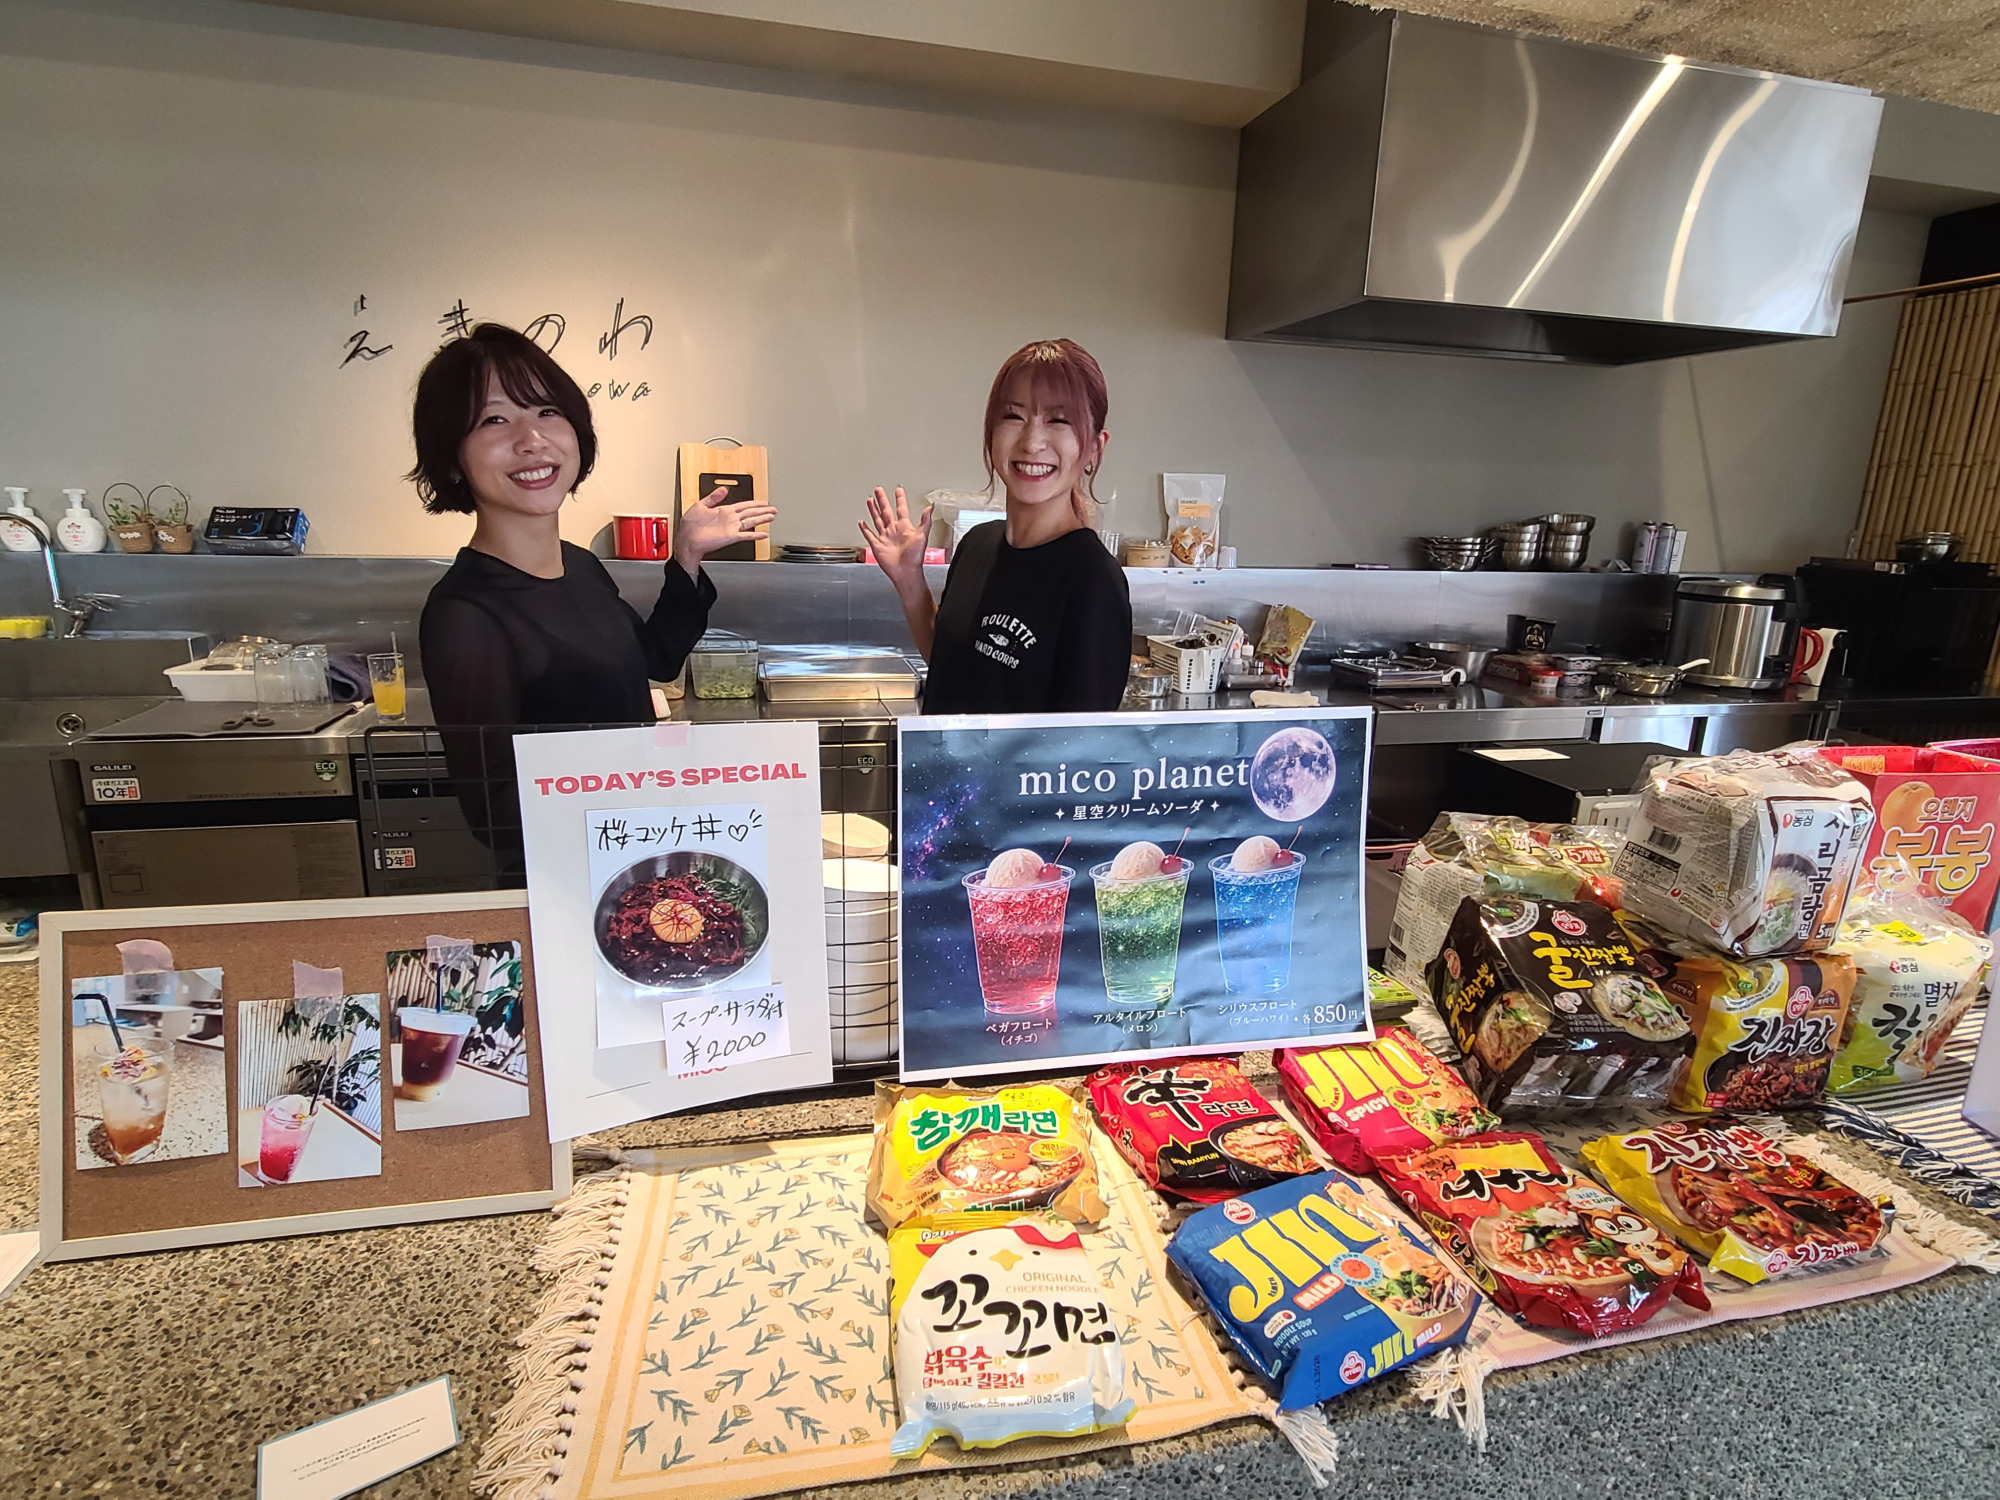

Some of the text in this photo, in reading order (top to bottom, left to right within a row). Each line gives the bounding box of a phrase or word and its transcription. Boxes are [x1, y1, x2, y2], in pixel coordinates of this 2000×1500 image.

[981, 614, 1037, 649] ROULETTE
[315, 762, 336, 771] ECO
[534, 763, 807, 796] TODAY'S SPECIAL
[1018, 757, 1249, 800] mico planet
[97, 786, 127, 798] 10年
[1072, 799, 1205, 821] 星空クリームソーダ
[1792, 815, 1814, 827] 농심
[1917, 796, 1977, 822] 오렌지
[1870, 823, 1995, 895] 봉봉
[1218, 1000, 1297, 1015] シリウスフロート
[1924, 981, 1959, 1008] 멸치
[986, 1019, 1053, 1034] ベガフロート
[1093, 1007, 1186, 1025] アルタイルフロート
[683, 1031, 766, 1067] ¥2000
[1728, 1015, 1837, 1063] 진짜장
[1122, 1065, 1213, 1132] 辛
[1200, 1101, 1258, 1117] 라면
[1345, 1095, 1391, 1122] SPICY
[1187, 1152, 1220, 1165] RAMYUN
[1621, 1125, 1787, 1174] 진짬뽕
[1005, 1285, 1100, 1294] CHICKEN NOODLE
[1022, 1271, 1087, 1283] ORIGINAL
[1295, 1274, 1343, 1309] MILD
[921, 1273, 1116, 1359] 꼬꼬면
[1273, 1317, 1313, 1349] NOODLE SOUP
[1416, 1322, 1442, 1348] MILD
